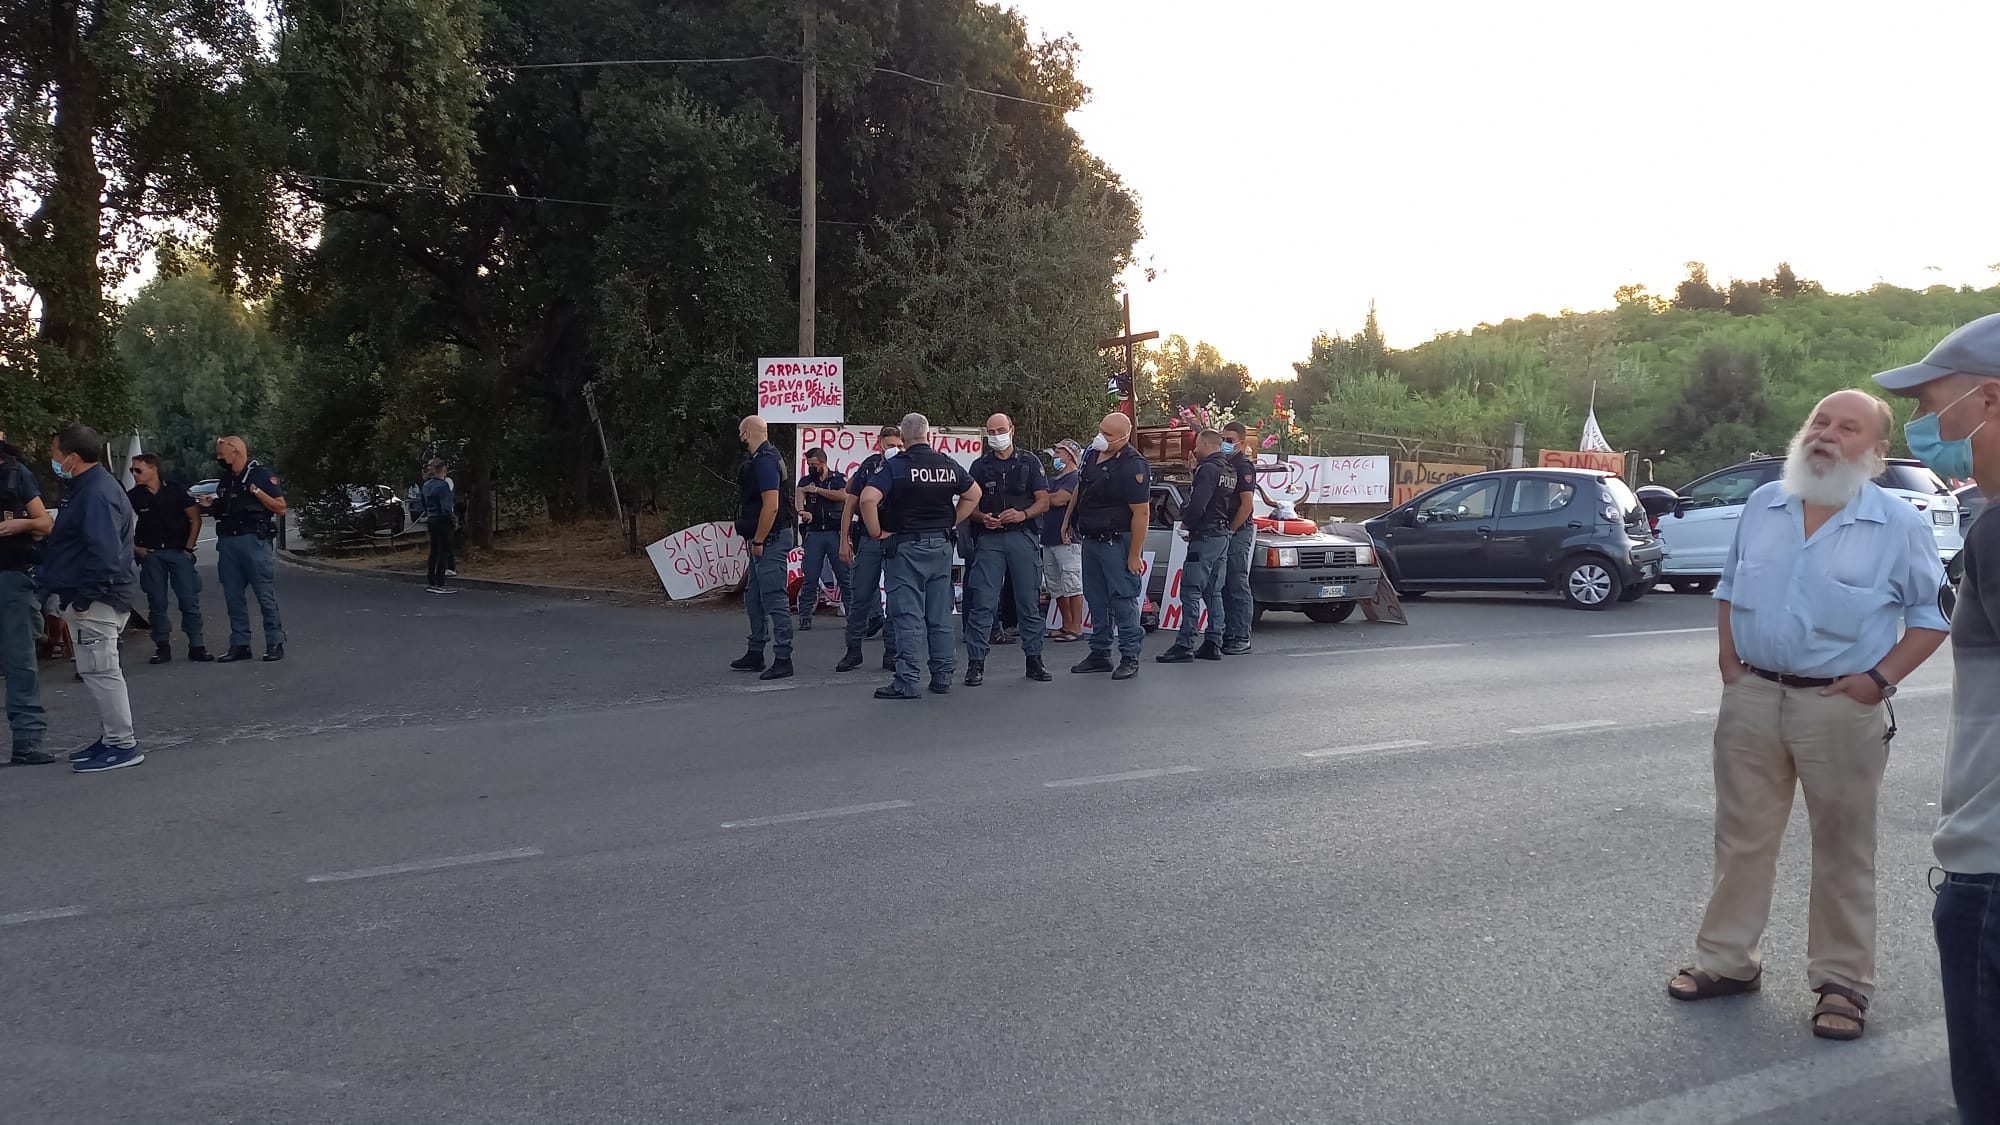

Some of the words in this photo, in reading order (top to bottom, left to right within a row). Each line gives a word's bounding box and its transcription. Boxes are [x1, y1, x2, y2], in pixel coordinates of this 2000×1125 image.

[758, 379, 803, 394] SERVA
[760, 391, 805, 408] POTERE
[1331, 458, 1375, 471] RAGGI
[1544, 451, 1624, 474] SINDACI
[911, 468, 957, 483] POLIZIA
[1395, 462, 1414, 484] LA
[674, 541, 750, 575] QUELLA
[694, 560, 748, 589] DISCARI
